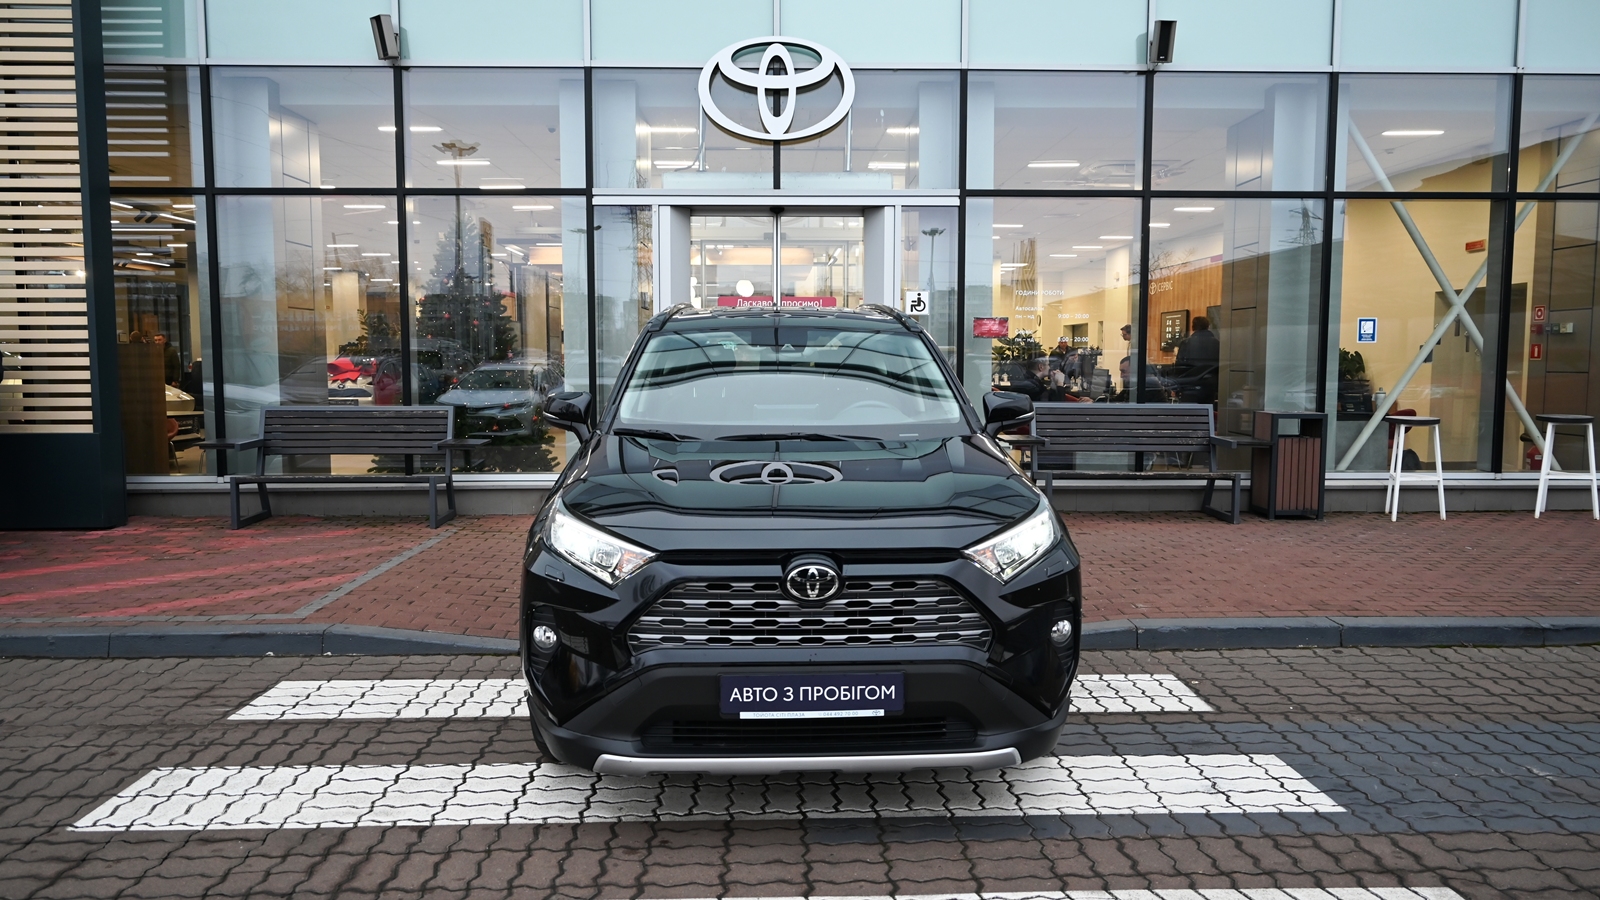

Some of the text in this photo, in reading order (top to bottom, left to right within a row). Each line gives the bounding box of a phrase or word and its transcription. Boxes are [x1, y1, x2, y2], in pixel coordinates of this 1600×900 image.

[729, 685, 896, 702] АВТО З ПРОБІГОМ
